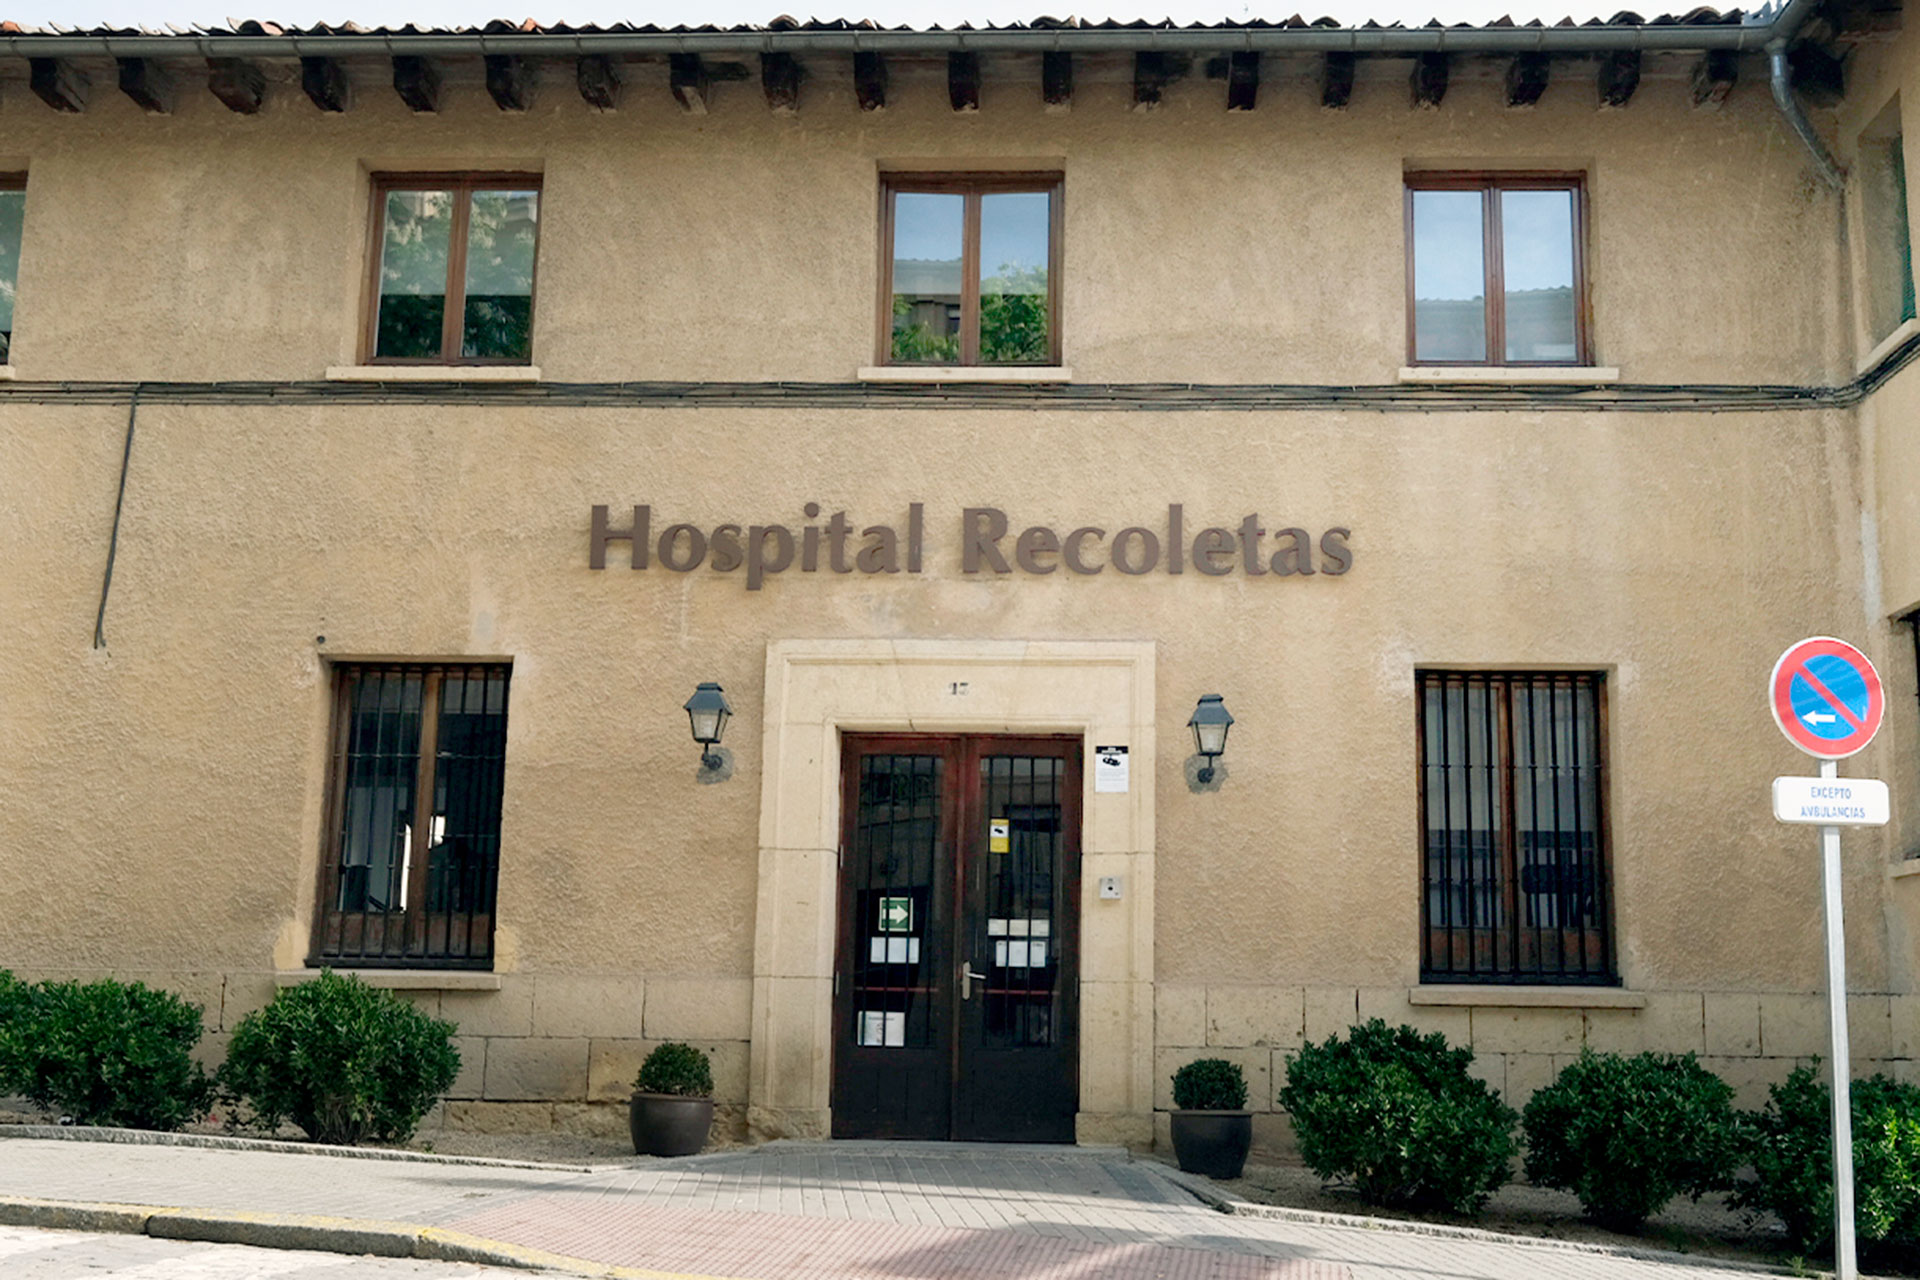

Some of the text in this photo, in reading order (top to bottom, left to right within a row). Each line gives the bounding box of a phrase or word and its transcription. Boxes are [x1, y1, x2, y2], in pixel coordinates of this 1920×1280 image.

[588, 502, 1353, 590] Hospital Recoletas
[1811, 786, 1852, 799] EXCEPTO
